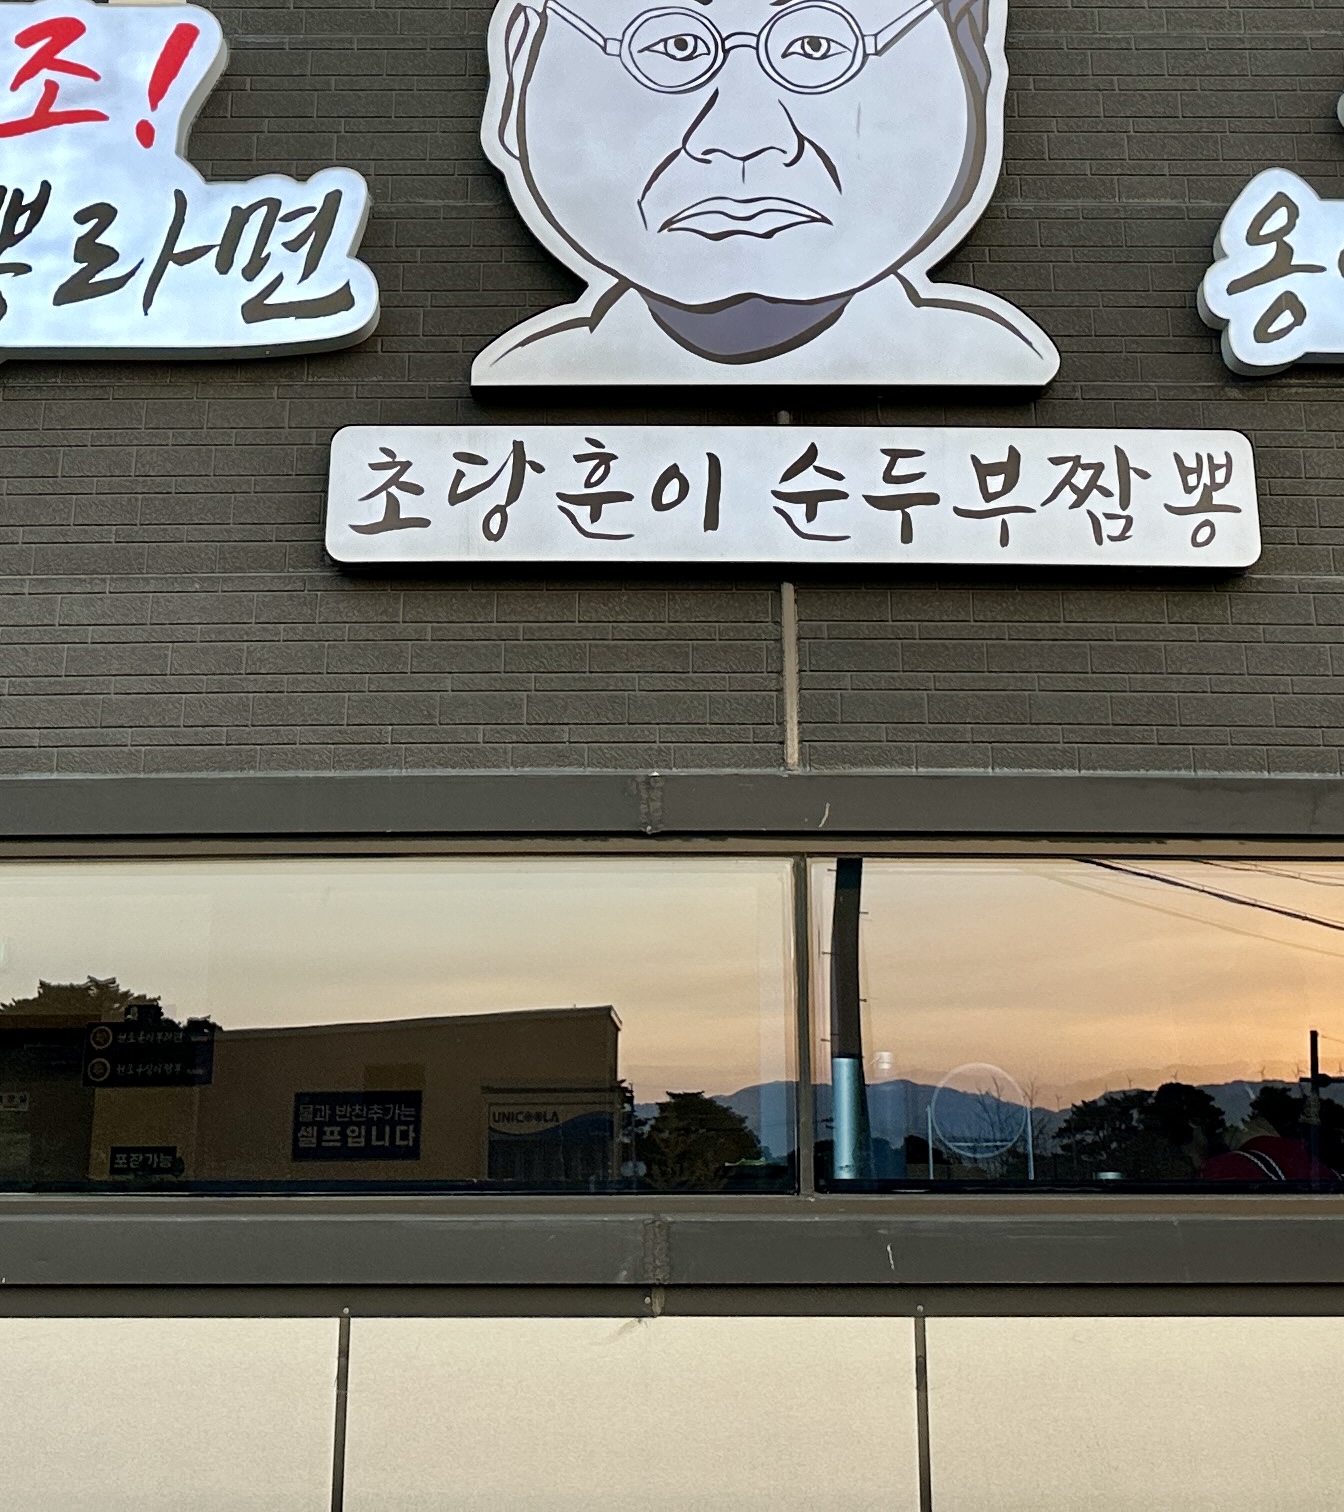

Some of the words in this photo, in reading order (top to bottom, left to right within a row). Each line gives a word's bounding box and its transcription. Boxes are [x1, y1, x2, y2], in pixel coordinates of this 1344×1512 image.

[347, 438, 722, 541] 초당훈이
[771, 441, 1244, 549] 순두부짬뽕
[297, 1125, 416, 1148] 셀프입니다
